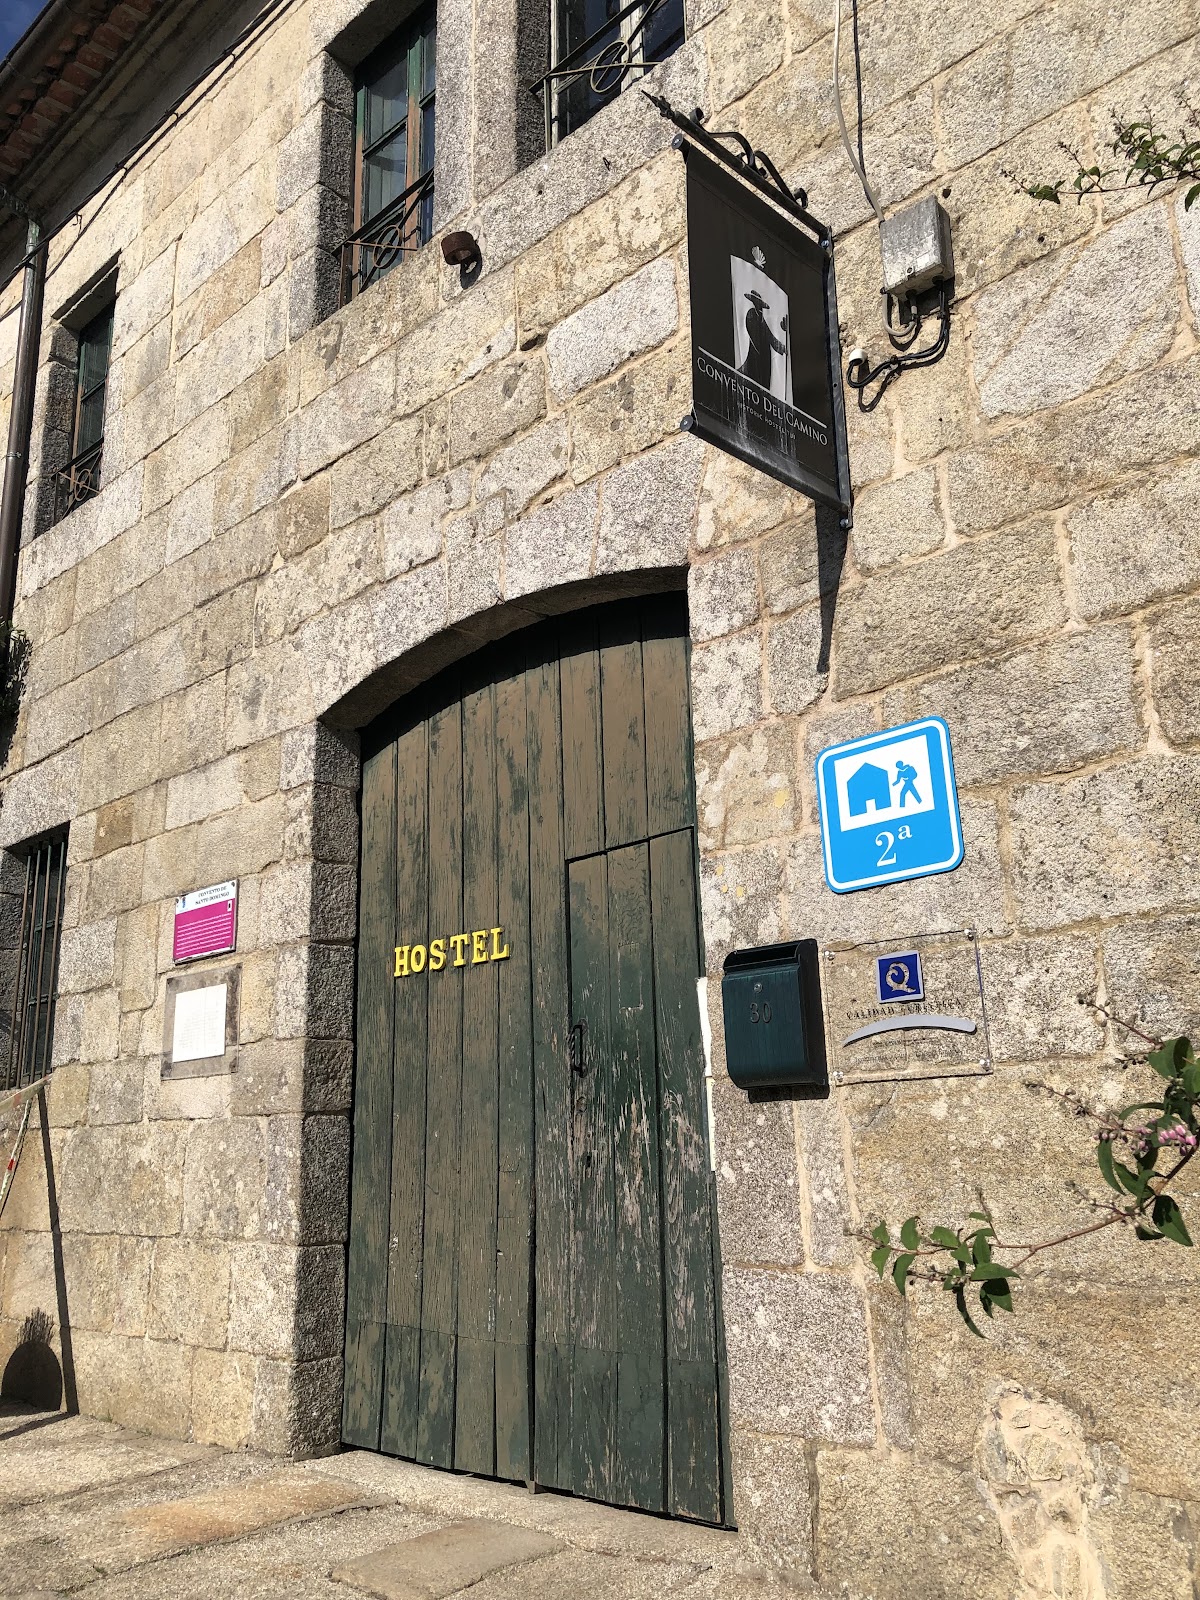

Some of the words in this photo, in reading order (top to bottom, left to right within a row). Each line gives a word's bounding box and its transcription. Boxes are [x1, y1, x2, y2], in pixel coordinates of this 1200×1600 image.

[697, 357, 760, 404] CONVENTO
[763, 396, 783, 420] DEL
[786, 411, 828, 446] CAMINO
[198, 887, 221, 898] CONVENTO
[394, 927, 510, 977] HOSTEL
[750, 1002, 772, 1024] 30
[846, 1005, 895, 1020] CALIDAD
